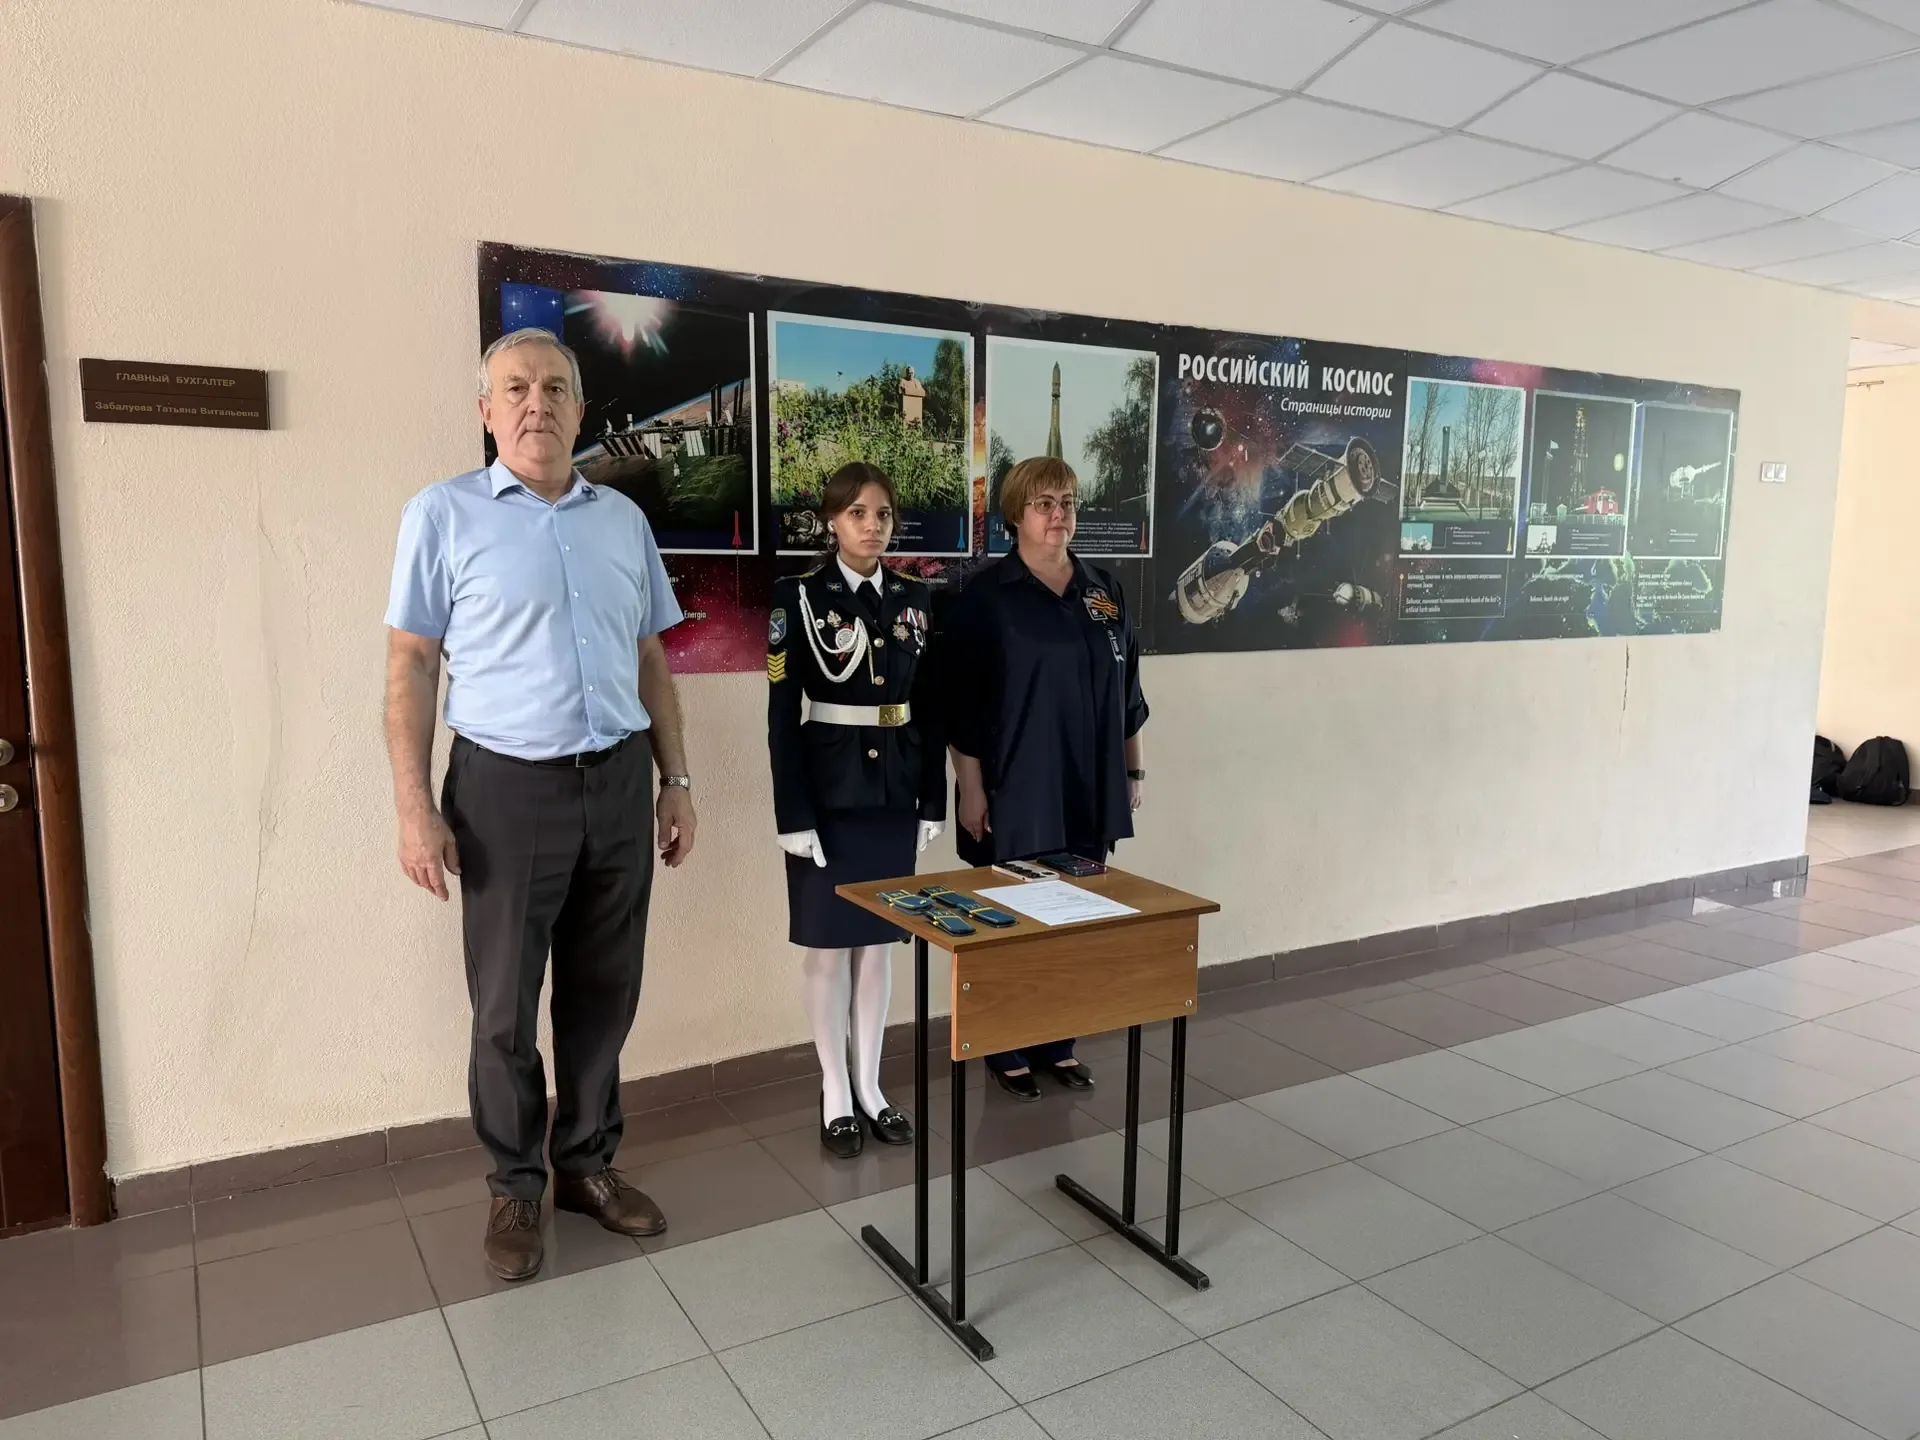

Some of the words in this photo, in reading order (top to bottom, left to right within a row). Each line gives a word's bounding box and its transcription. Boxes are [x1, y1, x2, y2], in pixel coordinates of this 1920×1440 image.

[116, 372, 169, 383] ГЛАВНЫЙ
[176, 376, 236, 387] БУХГАЛТЕР
[1178, 353, 1310, 389] РОССИЙСКИЙ
[1322, 366, 1394, 396] КОСМОС
[156, 404, 197, 415] Татьяна
[200, 407, 260, 418] Витальевна
[1280, 397, 1342, 415] Страницы
[1344, 404, 1392, 420] истории
